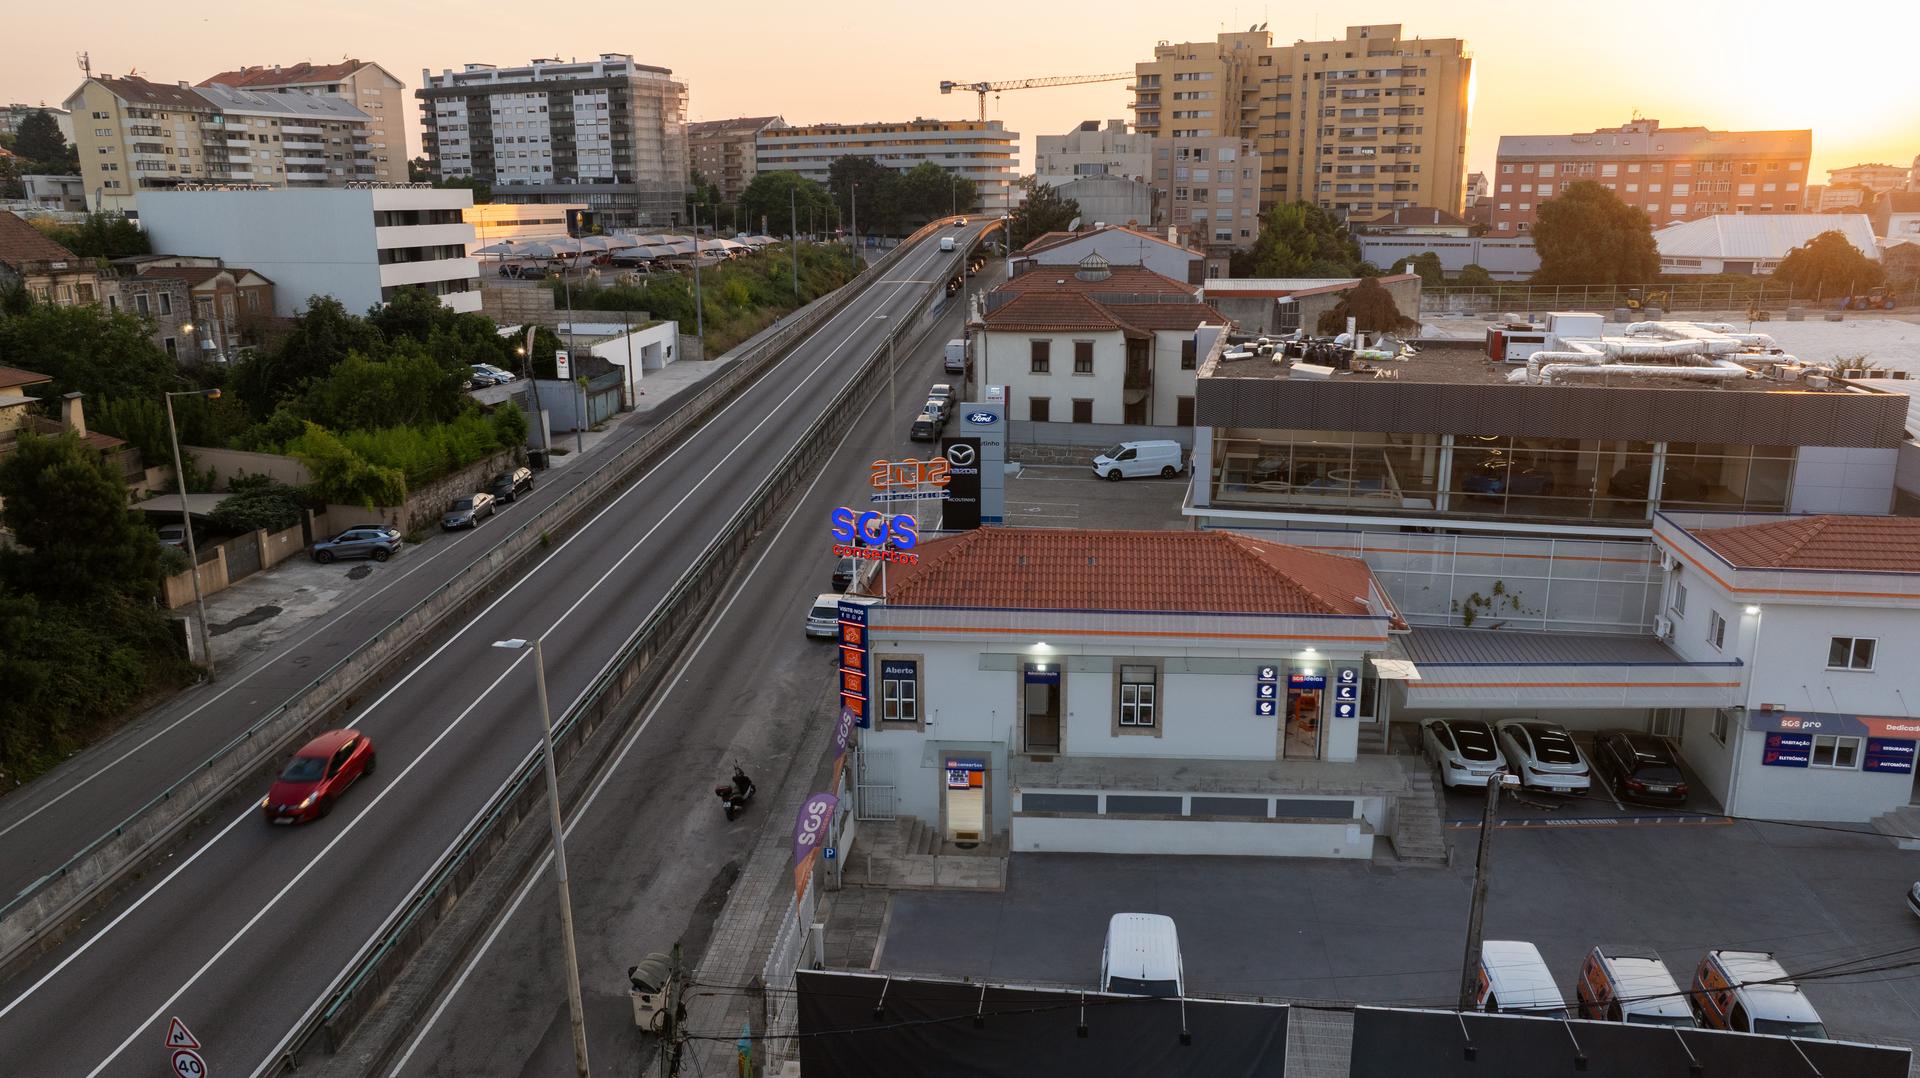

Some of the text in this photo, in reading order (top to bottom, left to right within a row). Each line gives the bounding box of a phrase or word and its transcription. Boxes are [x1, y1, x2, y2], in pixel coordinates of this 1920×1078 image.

[971, 413, 992, 422] Ford
[831, 507, 918, 550] SOS
[832, 545, 918, 566] consertos
[840, 606, 864, 616] VISITE-NOS
[885, 666, 914, 674] Aberto
[837, 712, 852, 748] SOS
[1802, 721, 1822, 729] pro
[798, 802, 826, 846] SOS
[826, 849, 833, 857] P
[179, 1060, 200, 1073] 40
